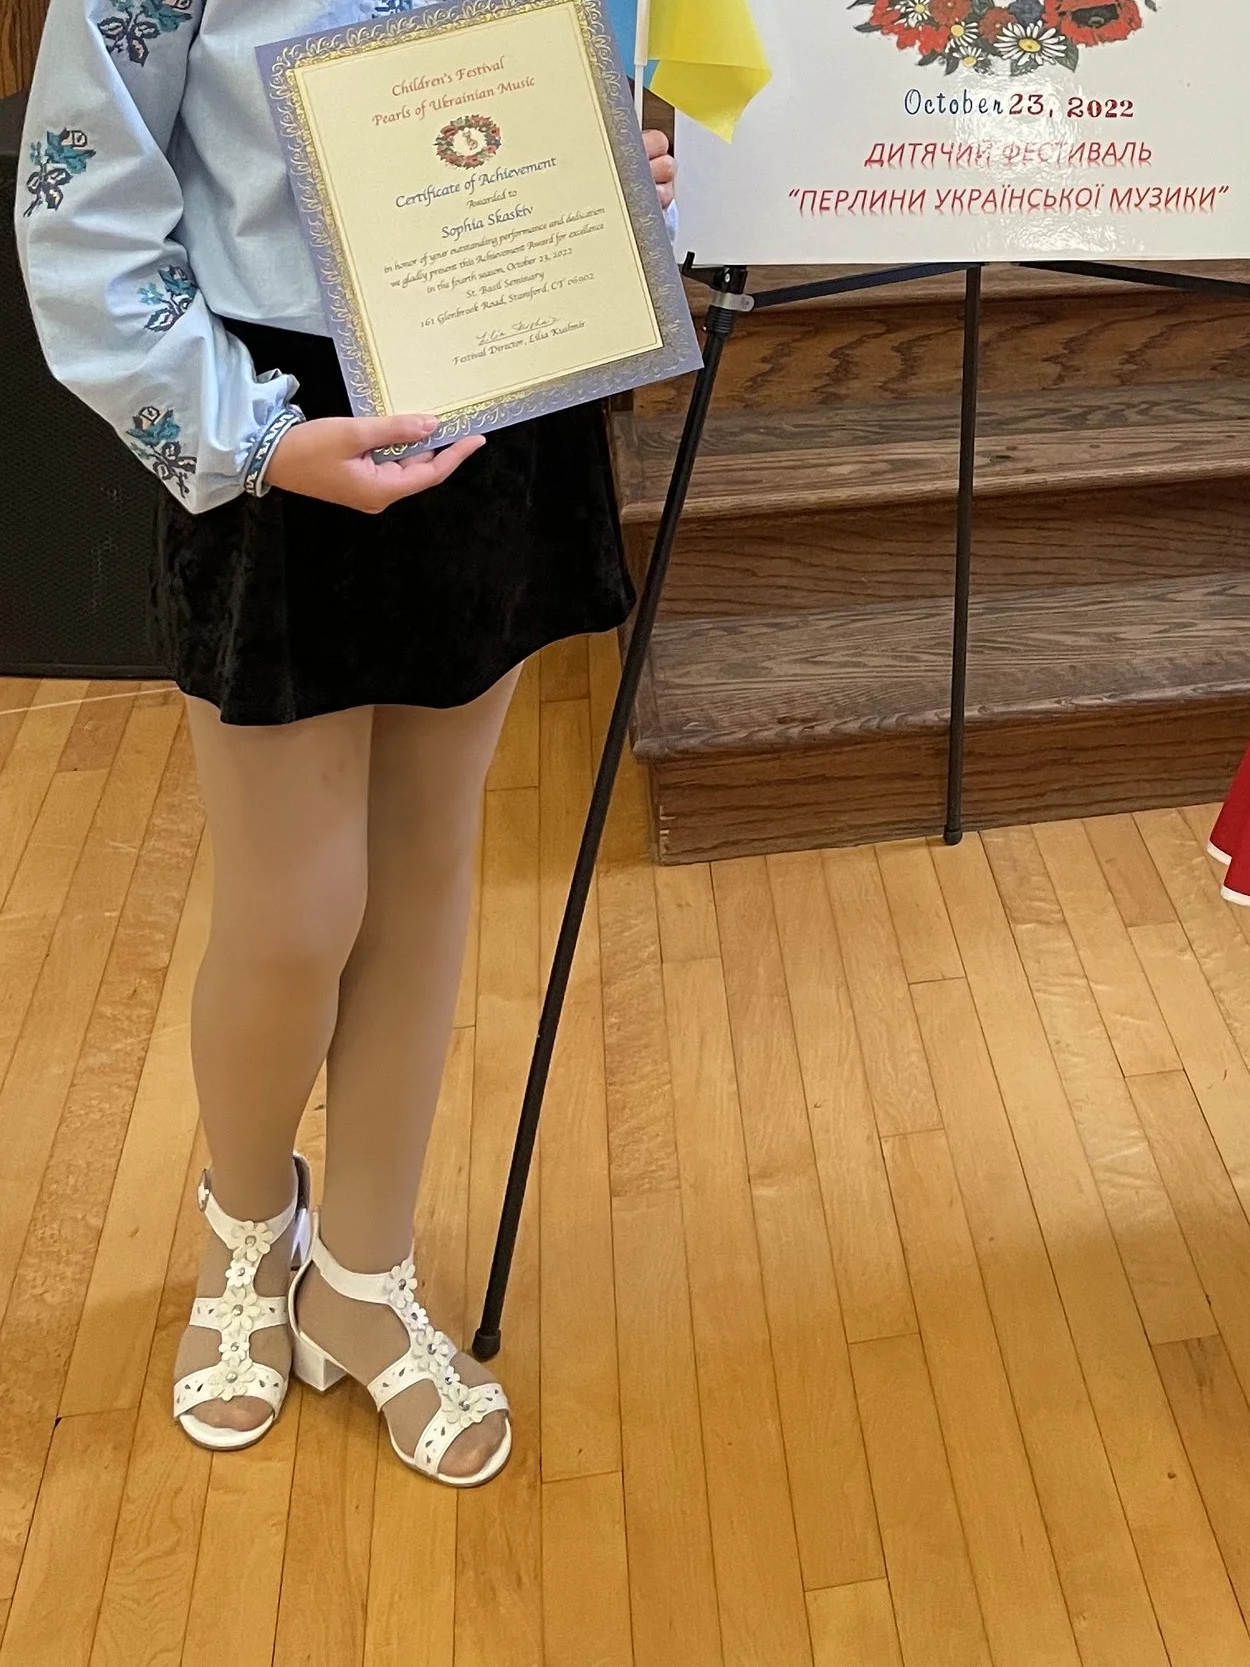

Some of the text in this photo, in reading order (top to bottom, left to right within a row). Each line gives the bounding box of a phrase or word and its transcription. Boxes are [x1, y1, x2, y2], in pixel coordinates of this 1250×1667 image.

[455, 55, 505, 81] Festival
[372, 76, 535, 126] Pearls of Ukrainian Music
[904, 89, 1134, 118] October 23, 2022
[864, 141, 1152, 167] ДИТЯЧИЙ ФЕСТИВАЛЬ
[395, 157, 557, 208] Certificate of Achievement
[466, 189, 506, 209] Awarded
[935, 184, 1104, 211] УКРАЇНСЬКОЇ
[441, 217, 484, 241] Sophia
[549, 214, 565, 228] and
[551, 277, 566, 290] CT
[452, 347, 487, 366] Festival
[529, 329, 549, 344] Lilia
